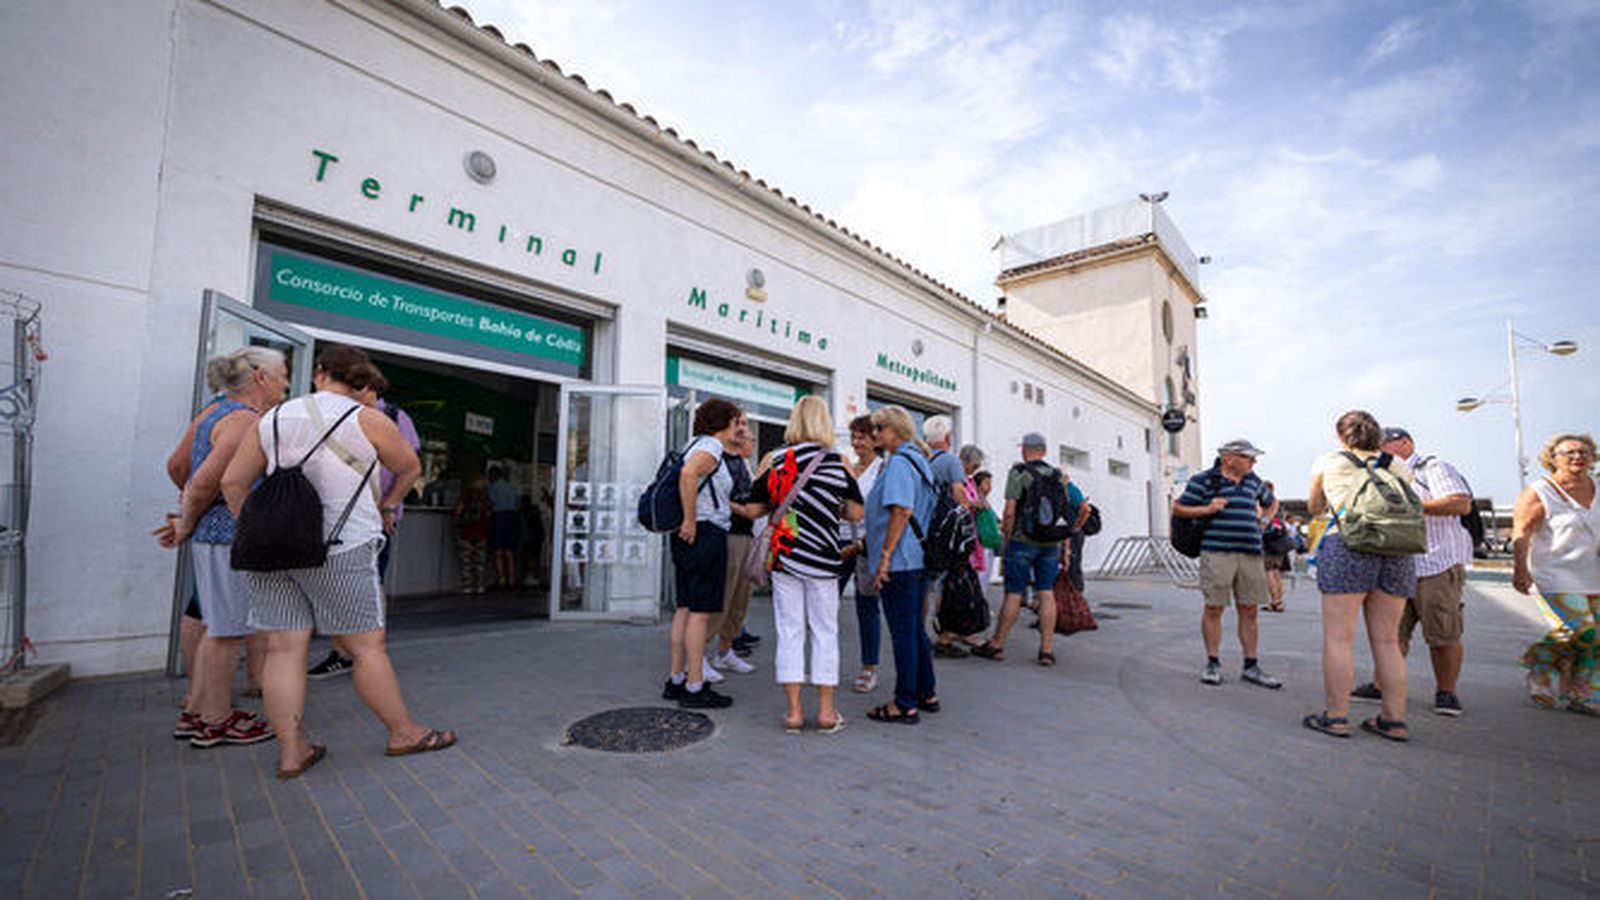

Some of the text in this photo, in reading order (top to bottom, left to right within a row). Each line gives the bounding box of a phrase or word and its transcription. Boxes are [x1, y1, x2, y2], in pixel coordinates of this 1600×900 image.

[312, 149, 602, 275] Terminal
[276, 267, 363, 302] Consorcio
[368, 290, 389, 308] de
[392, 295, 475, 328] Transportes
[525, 328, 542, 343] de
